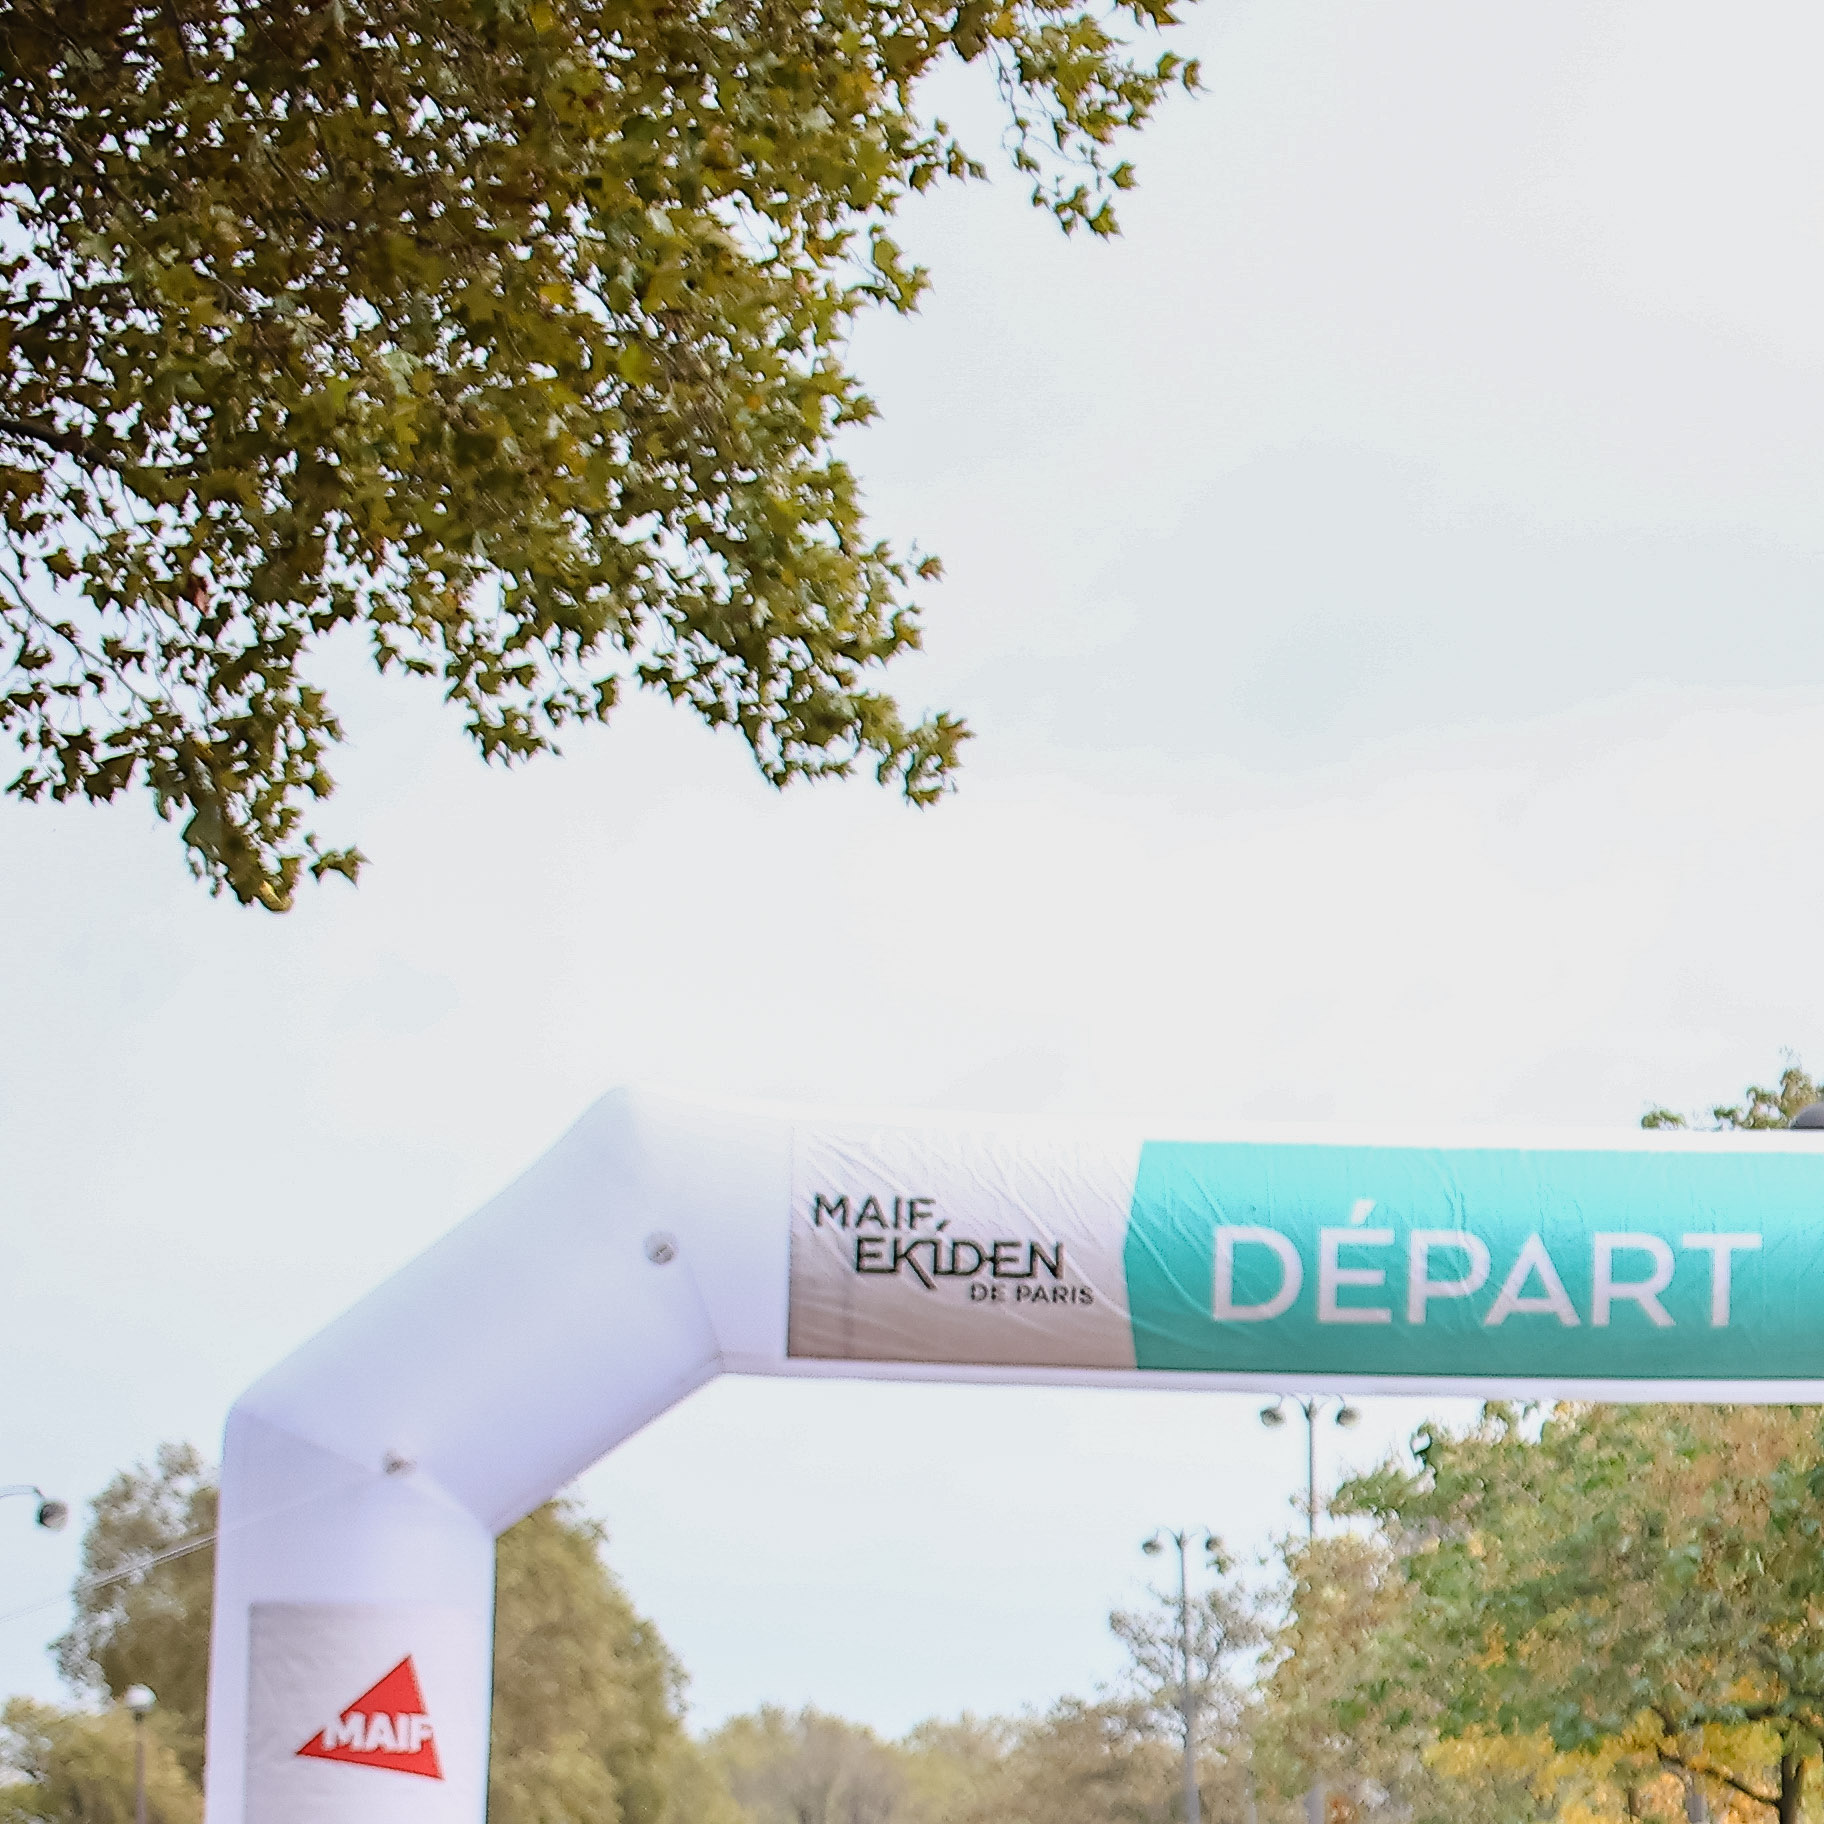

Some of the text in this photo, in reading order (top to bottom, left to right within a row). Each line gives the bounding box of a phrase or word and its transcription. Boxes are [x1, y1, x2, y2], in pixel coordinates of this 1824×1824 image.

[812, 1194, 936, 1229] MAIF
[857, 1237, 1064, 1290] EKIDEN
[1212, 1199, 1763, 1326] DÉPART
[970, 1283, 1094, 1304] DE PARIS
[322, 1711, 433, 1752] MAIF
